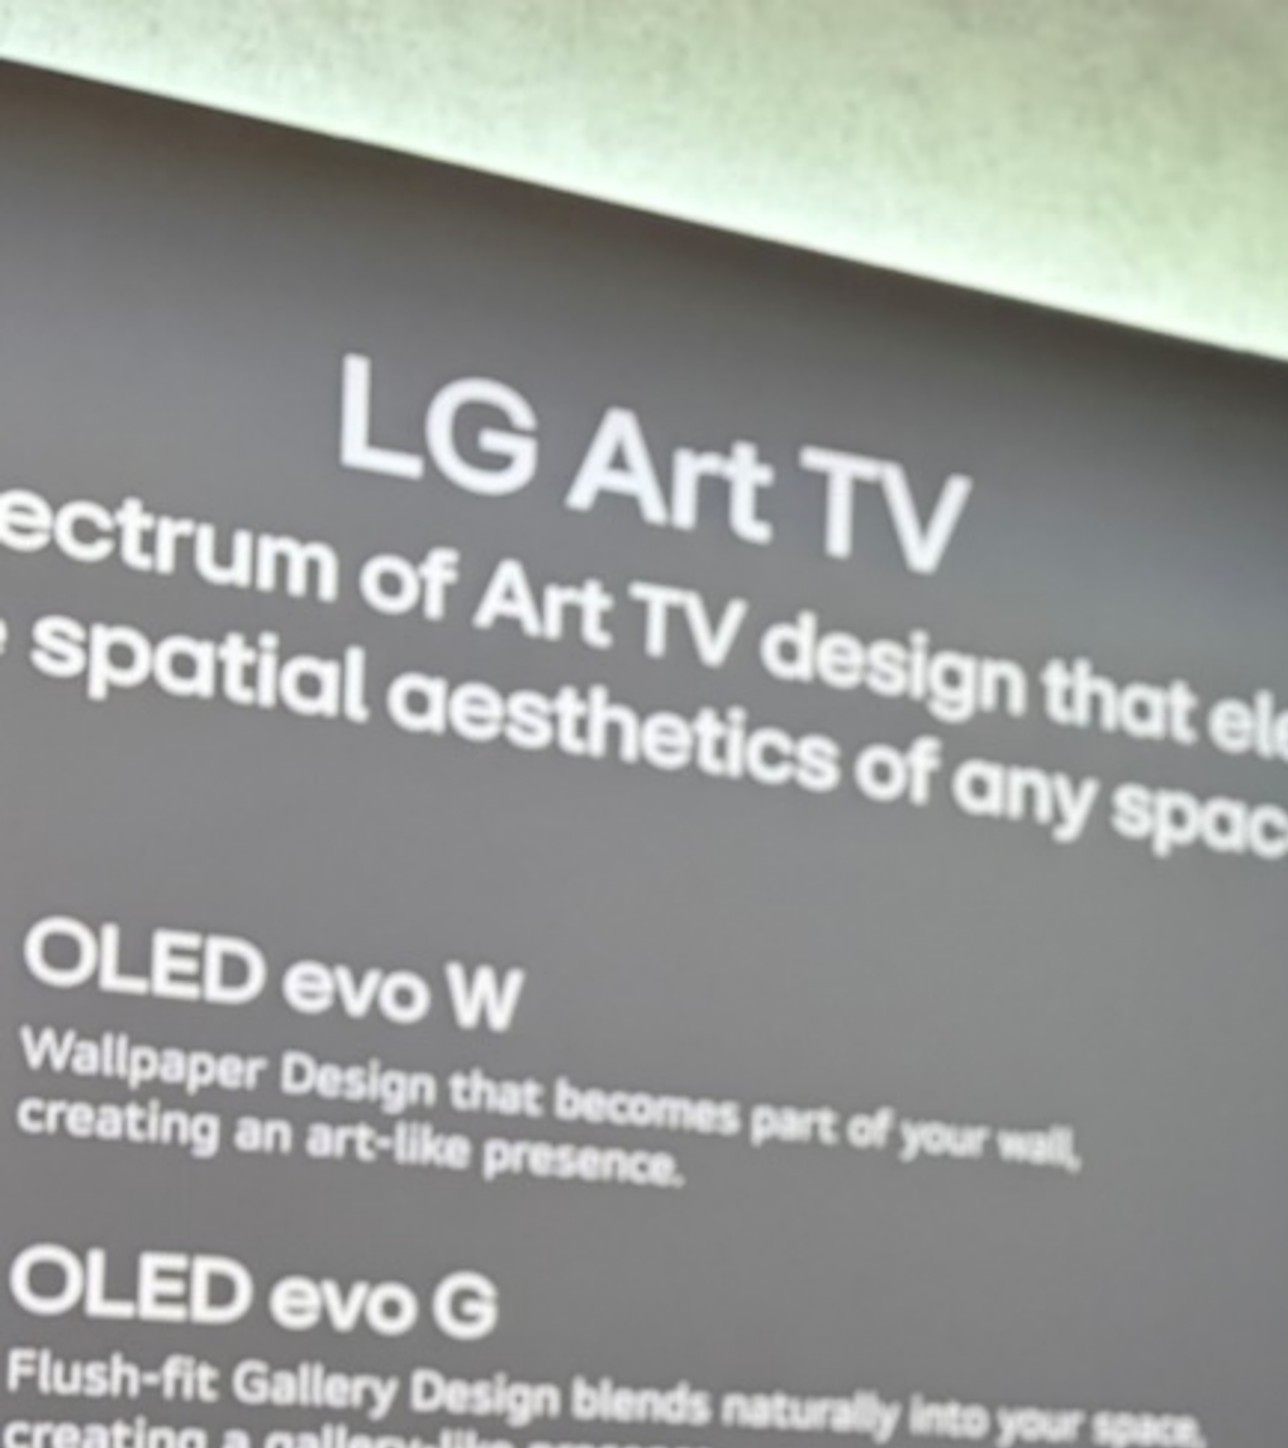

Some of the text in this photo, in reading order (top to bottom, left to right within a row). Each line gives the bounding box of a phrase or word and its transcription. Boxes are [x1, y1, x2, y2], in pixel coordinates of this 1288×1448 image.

[341, 354, 971, 573] LG Art TV
[0, 490, 338, 602] ectrum
[360, 548, 459, 620] of
[474, 559, 613, 648] Art
[629, 582, 747, 666] TV
[761, 611, 1026, 722] design
[1042, 659, 1197, 744] that
[31, 616, 369, 722] spatial
[387, 673, 840, 791] aesthetics
[855, 737, 940, 804] of
[953, 760, 1098, 842] any
[24, 917, 524, 1031] OLED evo W
[18, 1098, 683, 1185] creating an art-like presence.
[21, 1026, 1080, 1170] Wallpaper Design that becomes part of your wall,
[10, 1244, 497, 1339] OLED evo G
[8, 1348, 218, 1402] Flush-fit
[233, 1360, 398, 1420] Gallery
[411, 1369, 560, 1426] Design
[572, 1377, 711, 1425] blends
[722, 1393, 900, 1443] naturally
[910, 1396, 989, 1438] into
[998, 1409, 1084, 1448] your
